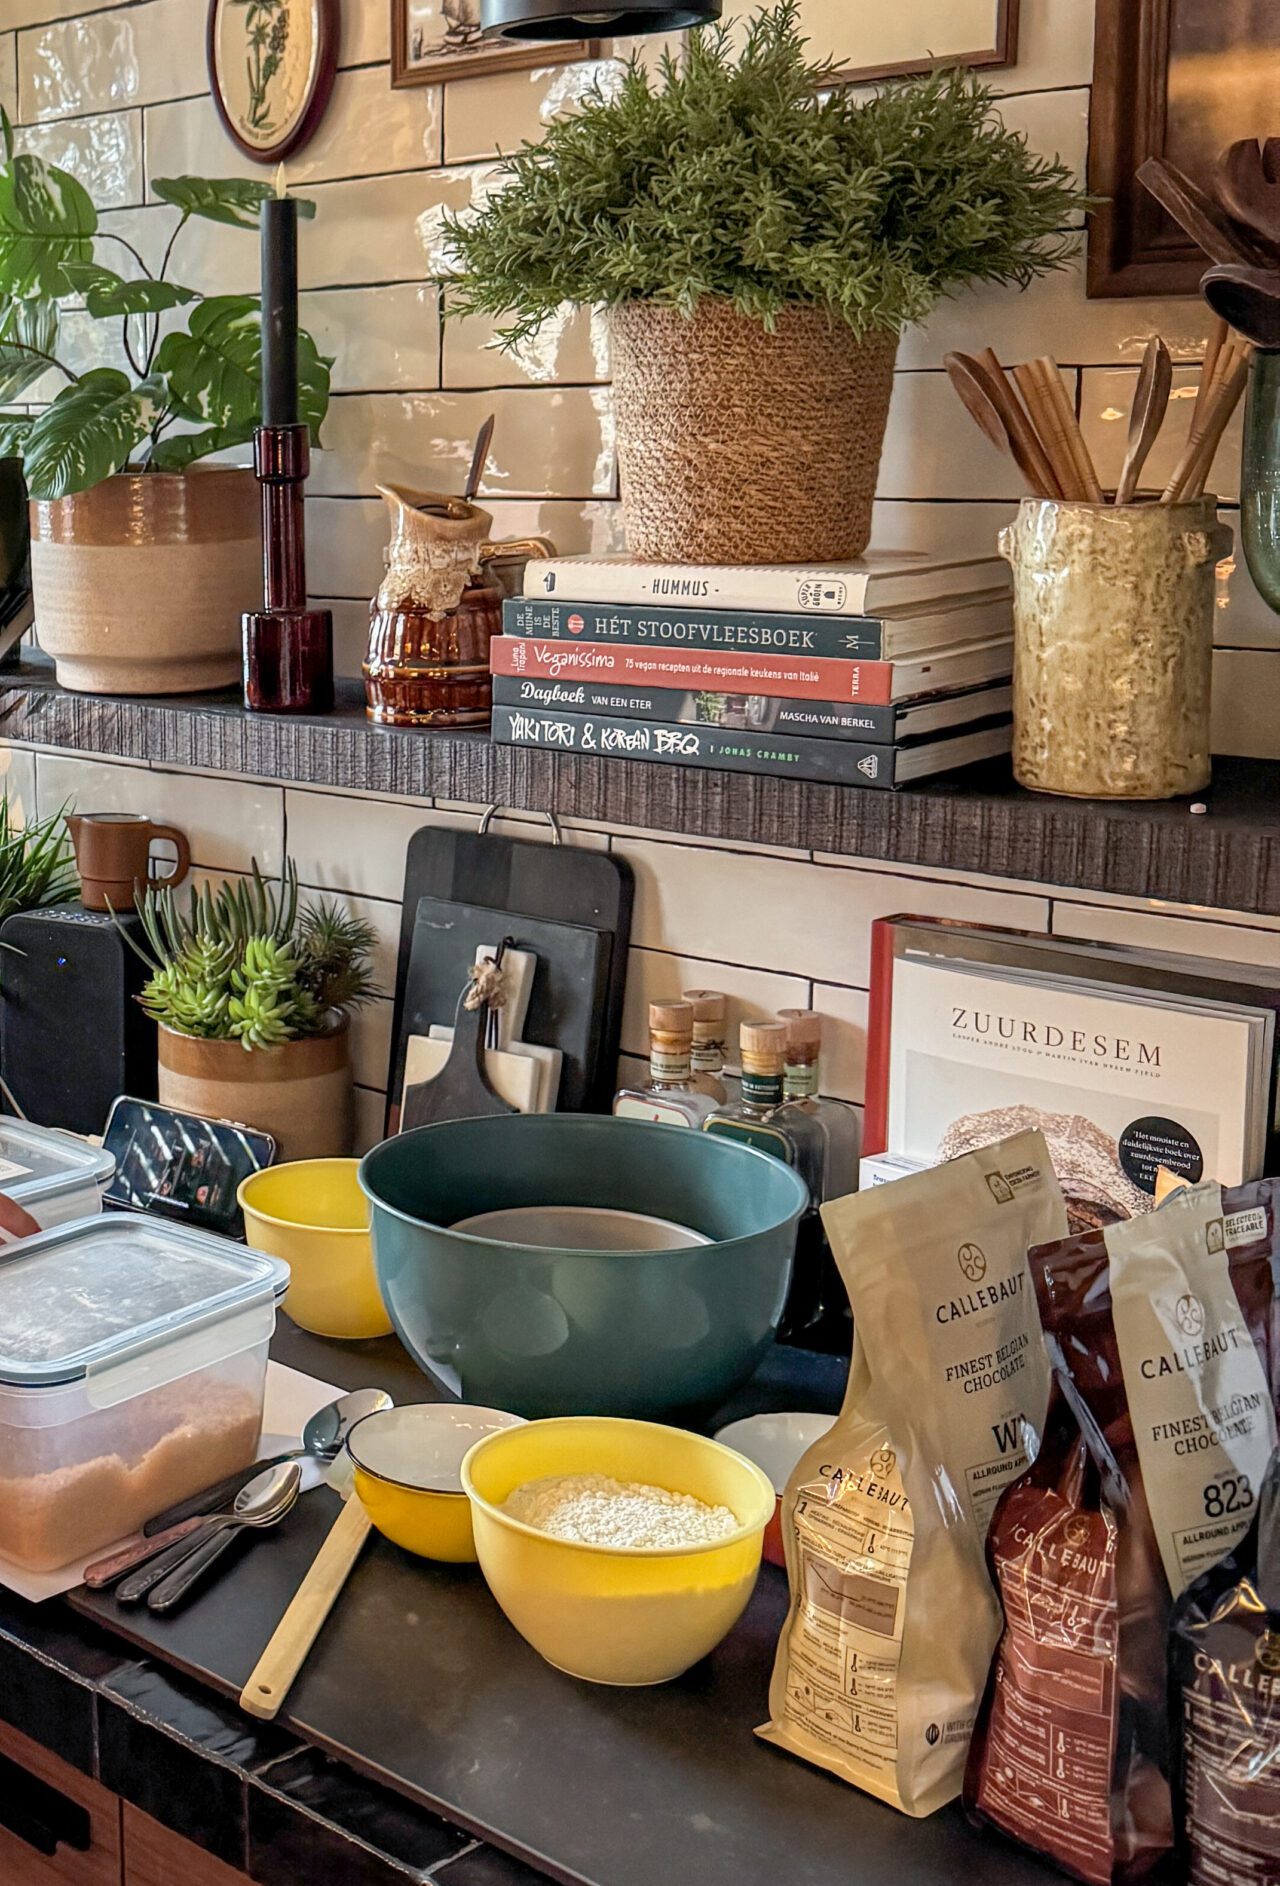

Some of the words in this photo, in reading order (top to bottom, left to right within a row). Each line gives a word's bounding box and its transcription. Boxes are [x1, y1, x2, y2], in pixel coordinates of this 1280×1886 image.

[652, 578, 710, 597] HUMMUS
[516, 613, 524, 627] DE
[534, 616, 542, 626] IS
[543, 614, 551, 628] DE
[595, 616, 631, 636] HÉT
[637, 619, 815, 648] STOOFVLEESBOEK
[534, 644, 615, 676] Veganissima
[625, 658, 634, 669] 75
[635, 661, 657, 672] vegan
[658, 662, 690, 674] recepten
[691, 664, 702, 673] uit
[702, 664, 712, 674] de
[713, 666, 749, 678] regionale
[750, 667, 781, 679] keukens
[783, 672, 798, 681] van
[851, 666, 860, 697] TERRA
[520, 681, 585, 706] Dagboek
[591, 695, 609, 706] VAN
[610, 697, 628, 708] EEN
[629, 698, 652, 710] ETER
[780, 711, 818, 723] MASCHA
[819, 715, 839, 725] VAN
[841, 717, 875, 729] BERKEL
[581, 722, 597, 750] &
[601, 727, 650, 751] KOREAN
[653, 728, 700, 755] BBQ
[719, 746, 751, 757] JONAS
[756, 750, 799, 762] CRAMBY
[952, 1007, 1161, 1067] ZUURDESEM
[1122, 1138, 1164, 1154] duidelijkste
[1164, 1147, 1182, 1157] boek
[1183, 1152, 1200, 1161] over
[1149, 1135, 1179, 1146] mooiste
[1180, 1141, 1189, 1149] en
[1130, 1151, 1191, 1170] zuurdesembrood
[1225, 1220, 1264, 1237] TRACEABLE
[936, 1271, 1024, 1324] CALLEBAUT
[945, 1353, 993, 1382] FINEST
[995, 1333, 1029, 1365] BELGIAN
[1141, 1328, 1238, 1379] CALLEBAUT
[963, 1353, 1025, 1394] CHOCOLATE
[1152, 1415, 1208, 1442] FINEST
[1211, 1393, 1261, 1424] BELGIAN
[972, 1460, 1013, 1480] ALLROUND
[1203, 1474, 1254, 1518] 823
[798, 1501, 808, 1515] 1
[1183, 1526, 1230, 1545] ALLROUND
[1193, 1652, 1280, 1696] CALLEB
